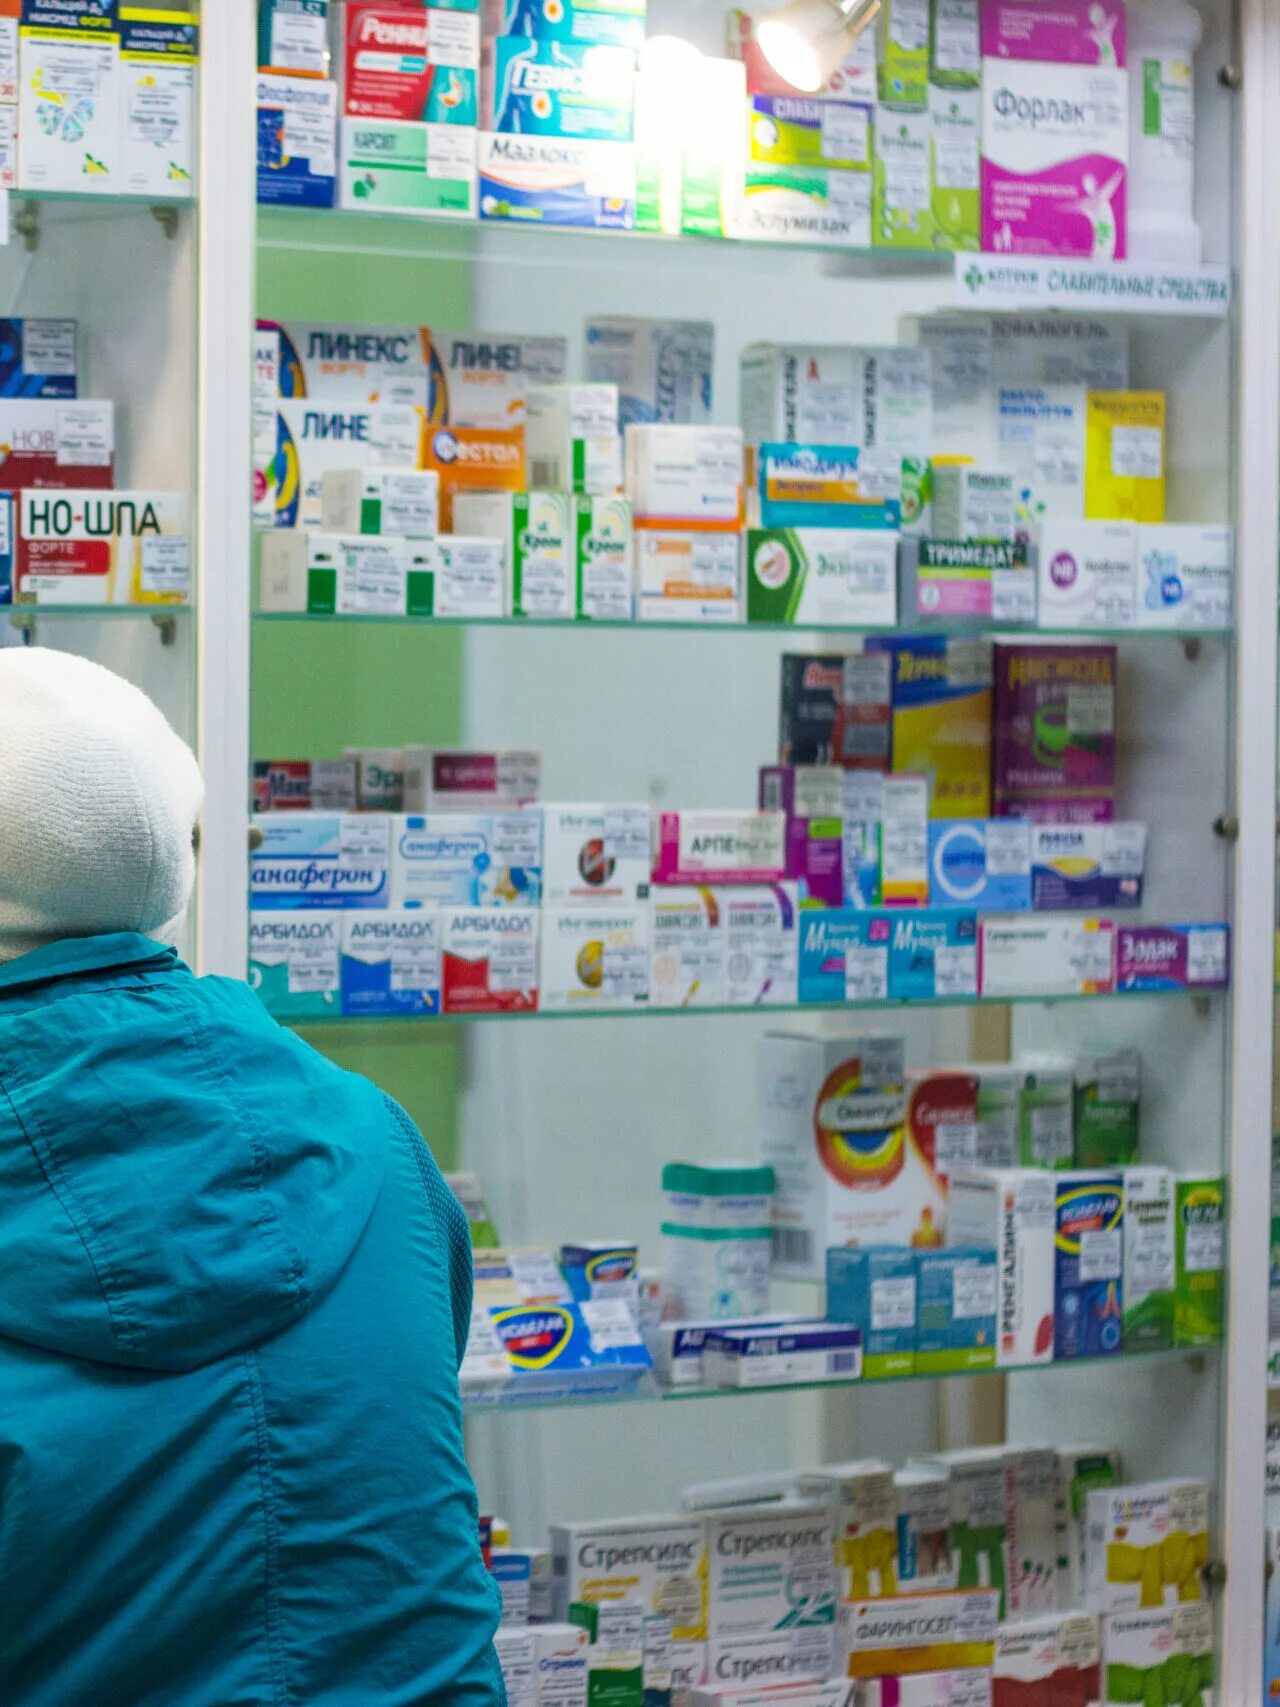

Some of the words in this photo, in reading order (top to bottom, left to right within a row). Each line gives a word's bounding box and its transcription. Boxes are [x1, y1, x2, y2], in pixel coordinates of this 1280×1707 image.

[993, 87, 1085, 128] Форлак
[307, 332, 410, 363] ЛИНЕКС
[29, 499, 161, 536] НО-ШПА
[29, 542, 75, 555] ФОРТЕ
[252, 863, 375, 889] анаферон
[250, 920, 333, 940] АРБИДОЛ
[351, 920, 433, 939] АРБИДОЛ
[451, 916, 532, 933] АРБИДОЛ
[578, 1540, 699, 1571] Стрепсилс
[718, 1527, 828, 1557] Стрепсилс
